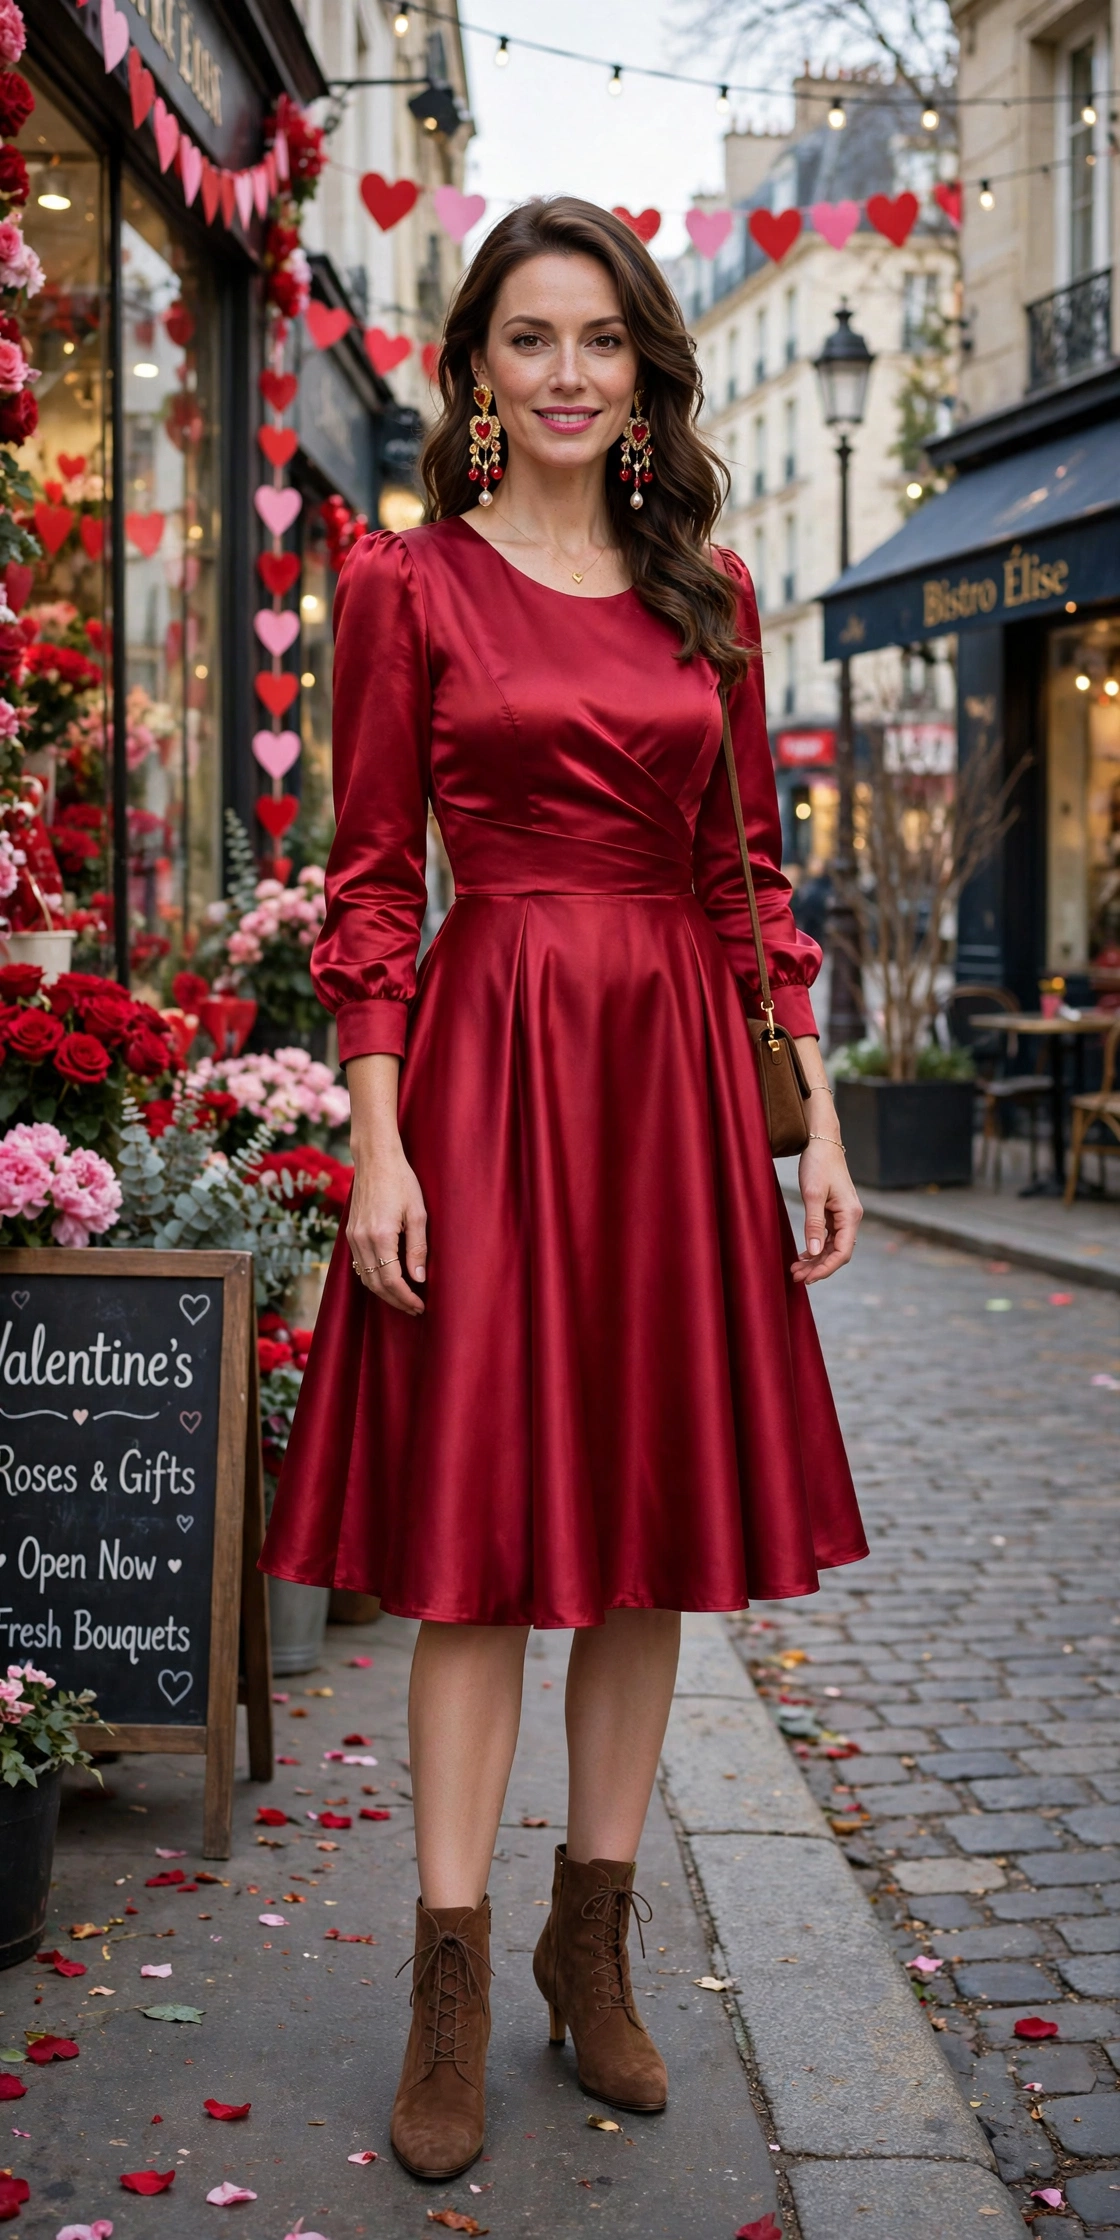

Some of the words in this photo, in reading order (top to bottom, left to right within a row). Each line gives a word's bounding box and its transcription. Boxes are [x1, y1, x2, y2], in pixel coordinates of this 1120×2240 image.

[923, 578, 997, 628] Bistro
[1003, 544, 1069, 608] Élise
[0, 1444, 78, 1497] Roses
[90, 1460, 108, 1492] &
[119, 1448, 196, 1504] Gifts
[18, 1536, 86, 1593] Open
[98, 1538, 157, 1581] Now
[73, 1609, 191, 1664] Bouquets
